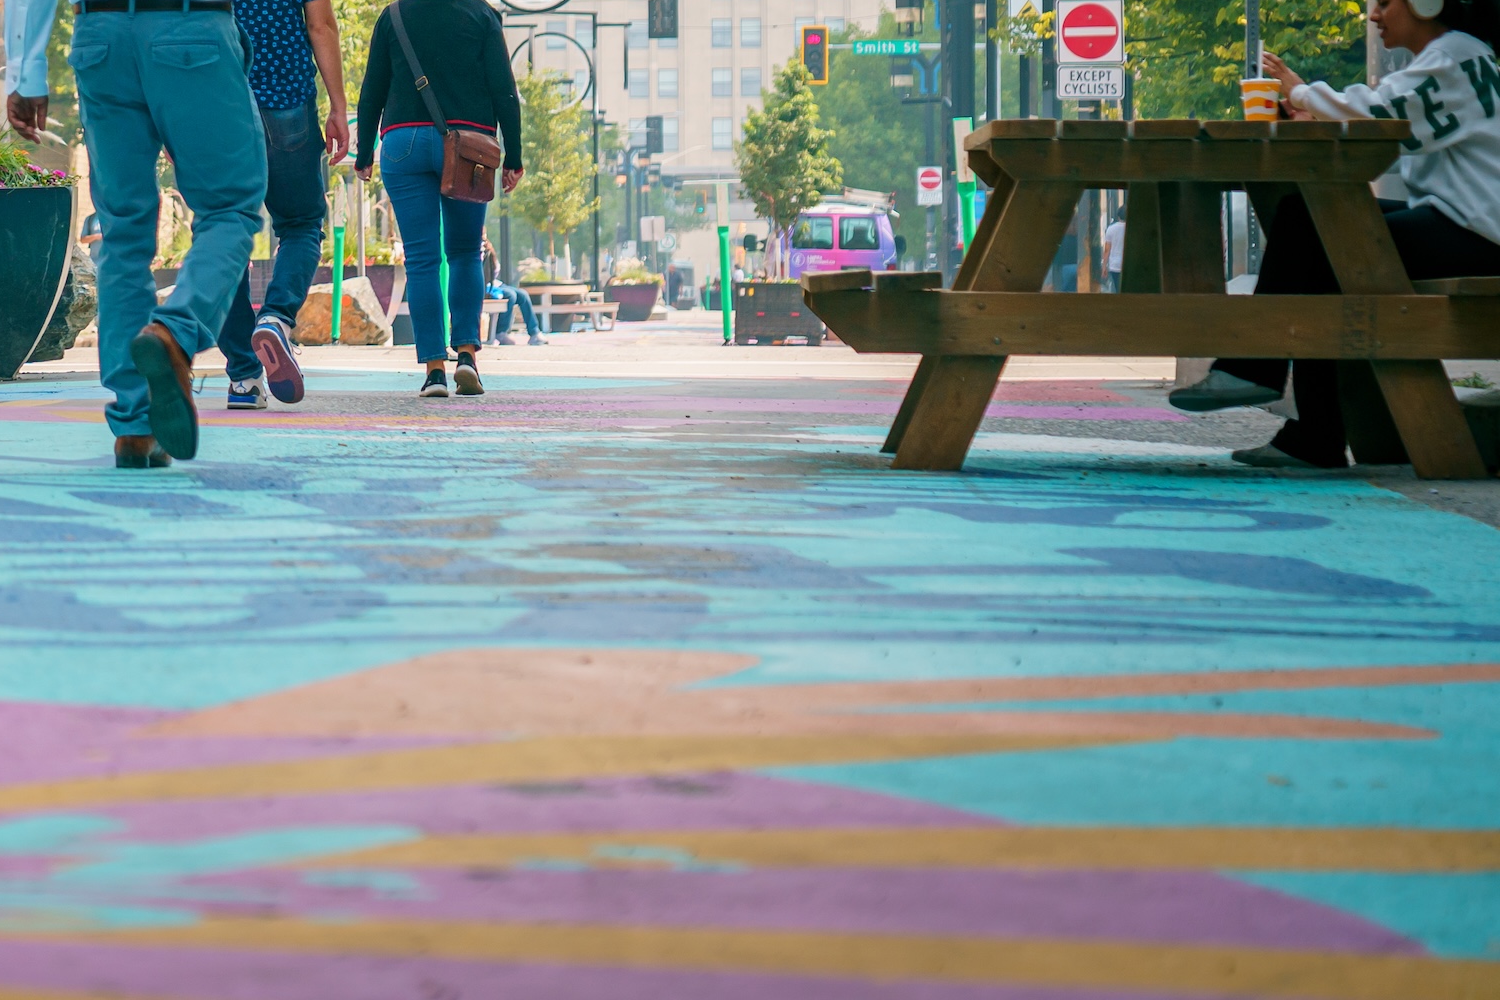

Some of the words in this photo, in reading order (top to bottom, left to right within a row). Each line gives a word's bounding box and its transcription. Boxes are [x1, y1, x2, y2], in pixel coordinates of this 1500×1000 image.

[856, 40, 896, 54] Smith
[904, 41, 918, 54] St
[1070, 70, 1112, 81] EXCEPT
[1064, 83, 1118, 95] CYCLISTS
